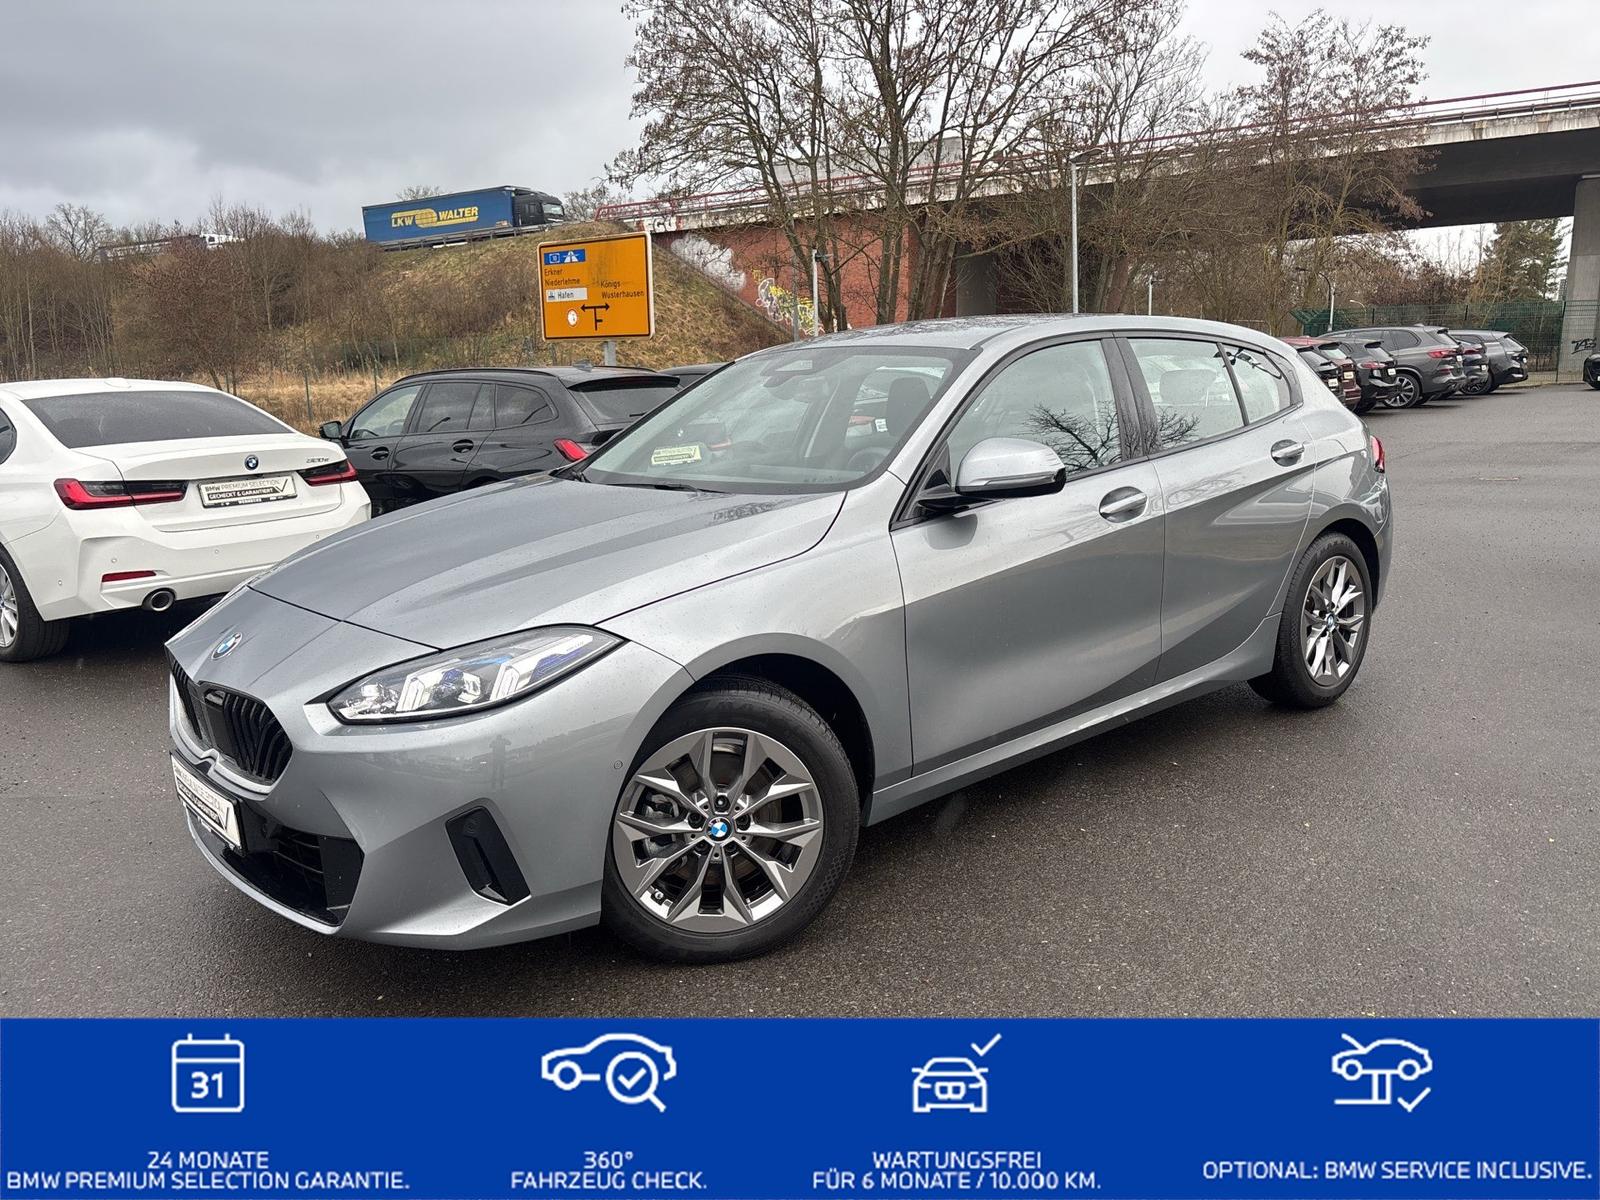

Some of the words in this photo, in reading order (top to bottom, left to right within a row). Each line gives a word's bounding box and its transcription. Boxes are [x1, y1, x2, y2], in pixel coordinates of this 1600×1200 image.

[392, 215, 413, 228] LKW
[439, 206, 479, 220] WALTER
[544, 268, 563, 276] Erkner
[544, 278, 580, 287] Niederlehme
[557, 291, 574, 299] Hafen
[601, 290, 645, 299] Wusterhausen
[221, 481, 248, 490] PREMIUM
[249, 478, 280, 487] SELECTION
